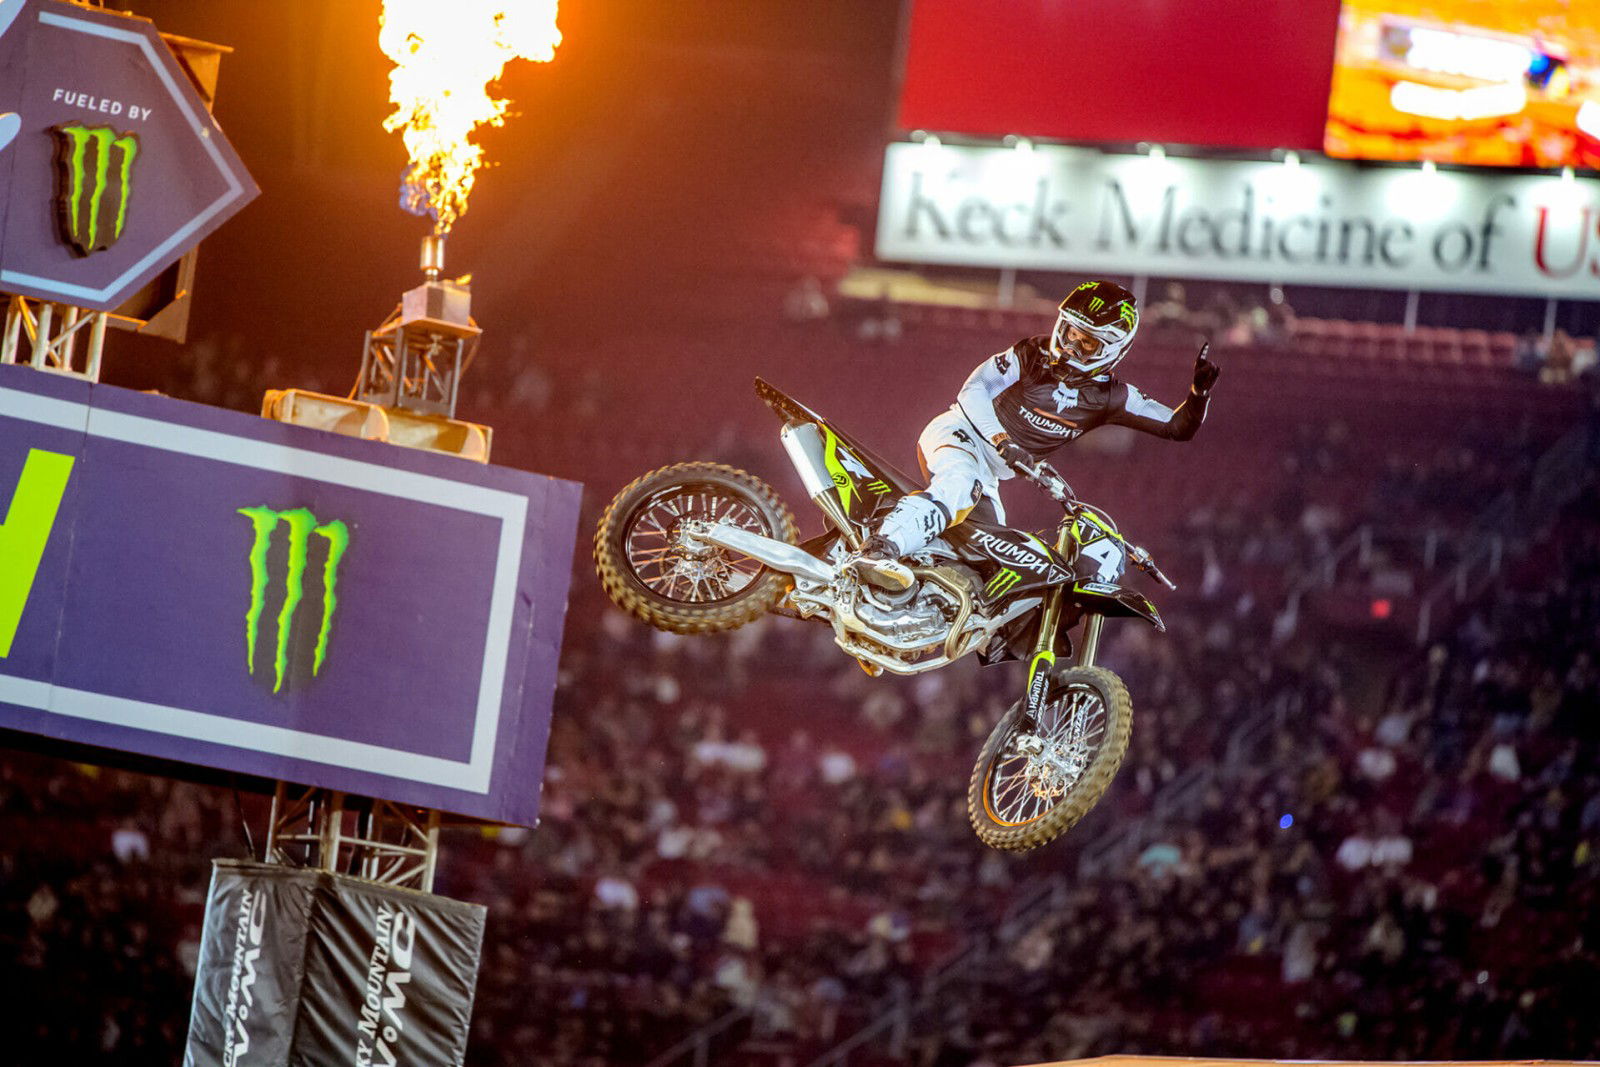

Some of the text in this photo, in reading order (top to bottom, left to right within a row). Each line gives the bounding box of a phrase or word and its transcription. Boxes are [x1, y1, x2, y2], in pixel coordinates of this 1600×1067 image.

[53, 88, 152, 121] FUELED BY
[903, 170, 1600, 281] Keck Medicine of U
[1018, 405, 1071, 438] TRIUMPH
[970, 529, 1050, 575] TRIUMPH
[1080, 538, 1122, 583] 4
[1028, 671, 1045, 709] TRIUMPH
[225, 889, 253, 1020] MOUNTAIN
[357, 906, 394, 1039] MOUNTAIN
